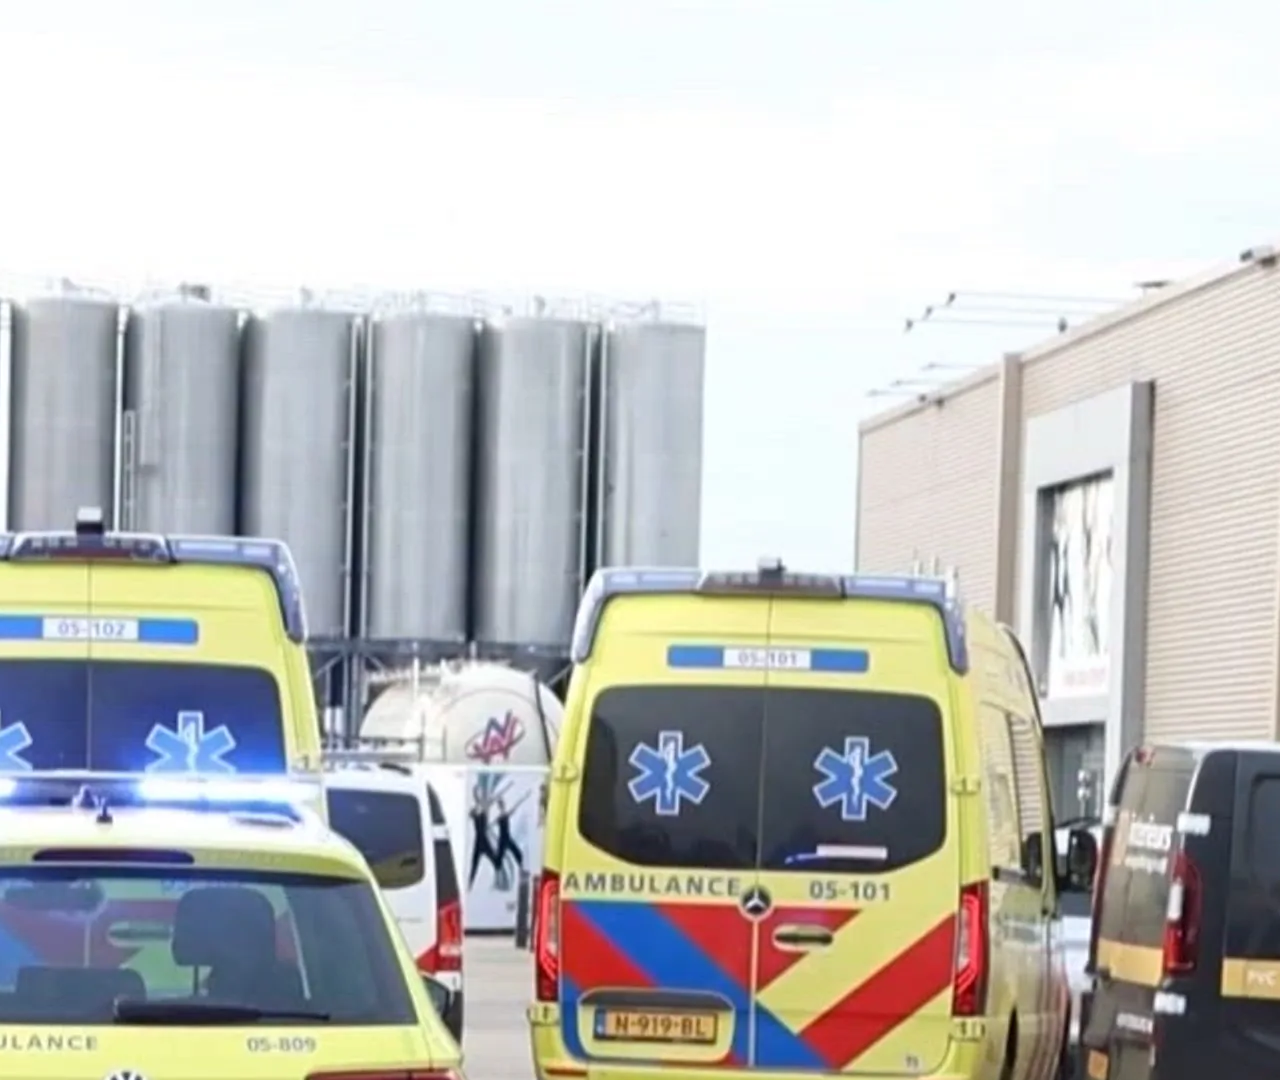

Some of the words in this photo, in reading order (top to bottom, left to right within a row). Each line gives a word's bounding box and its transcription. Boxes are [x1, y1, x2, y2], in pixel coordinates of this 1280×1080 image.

[57, 621, 126, 638] 05-102
[737, 651, 798, 666] 05-101
[563, 872, 741, 897] AMBULANCE
[808, 880, 892, 901] 05-101
[1247, 969, 1277, 987] PVC
[614, 1015, 707, 1037] N-919-BL
[246, 1037, 318, 1053] 05-809
